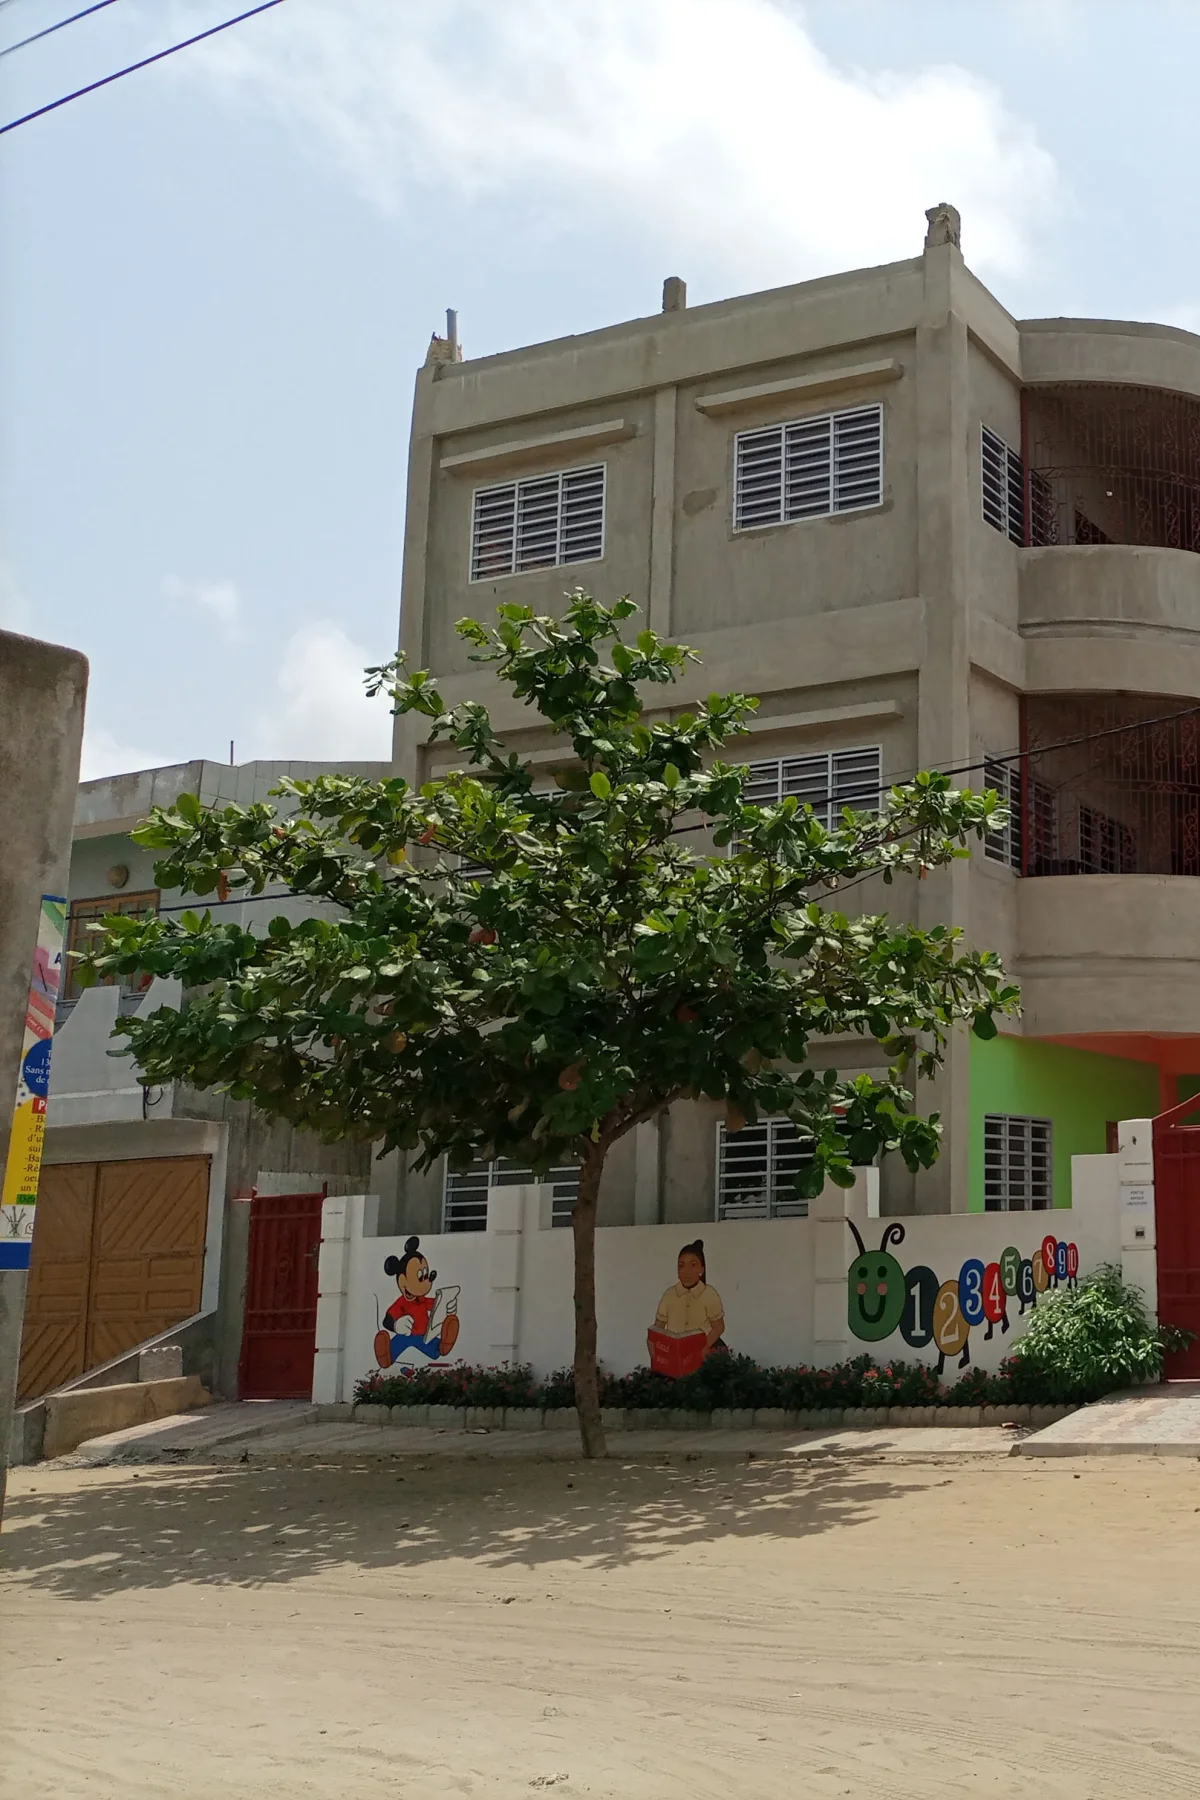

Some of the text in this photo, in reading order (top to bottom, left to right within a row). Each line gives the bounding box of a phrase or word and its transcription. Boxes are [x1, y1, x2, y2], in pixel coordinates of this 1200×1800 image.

[25, 1065, 44, 1074] Sans
[910, 1281, 926, 1337] 1
[940, 1291, 959, 1345] 2
[966, 1268, 982, 1315] 3
[989, 1272, 1002, 1314] 4
[1004, 1254, 1017, 1289] 5
[1022, 1265, 1034, 1296] 6
[1046, 1242, 1055, 1268] 8
[1058, 1248, 1066, 1274] 9
[1067, 1248, 1077, 1271] 10
